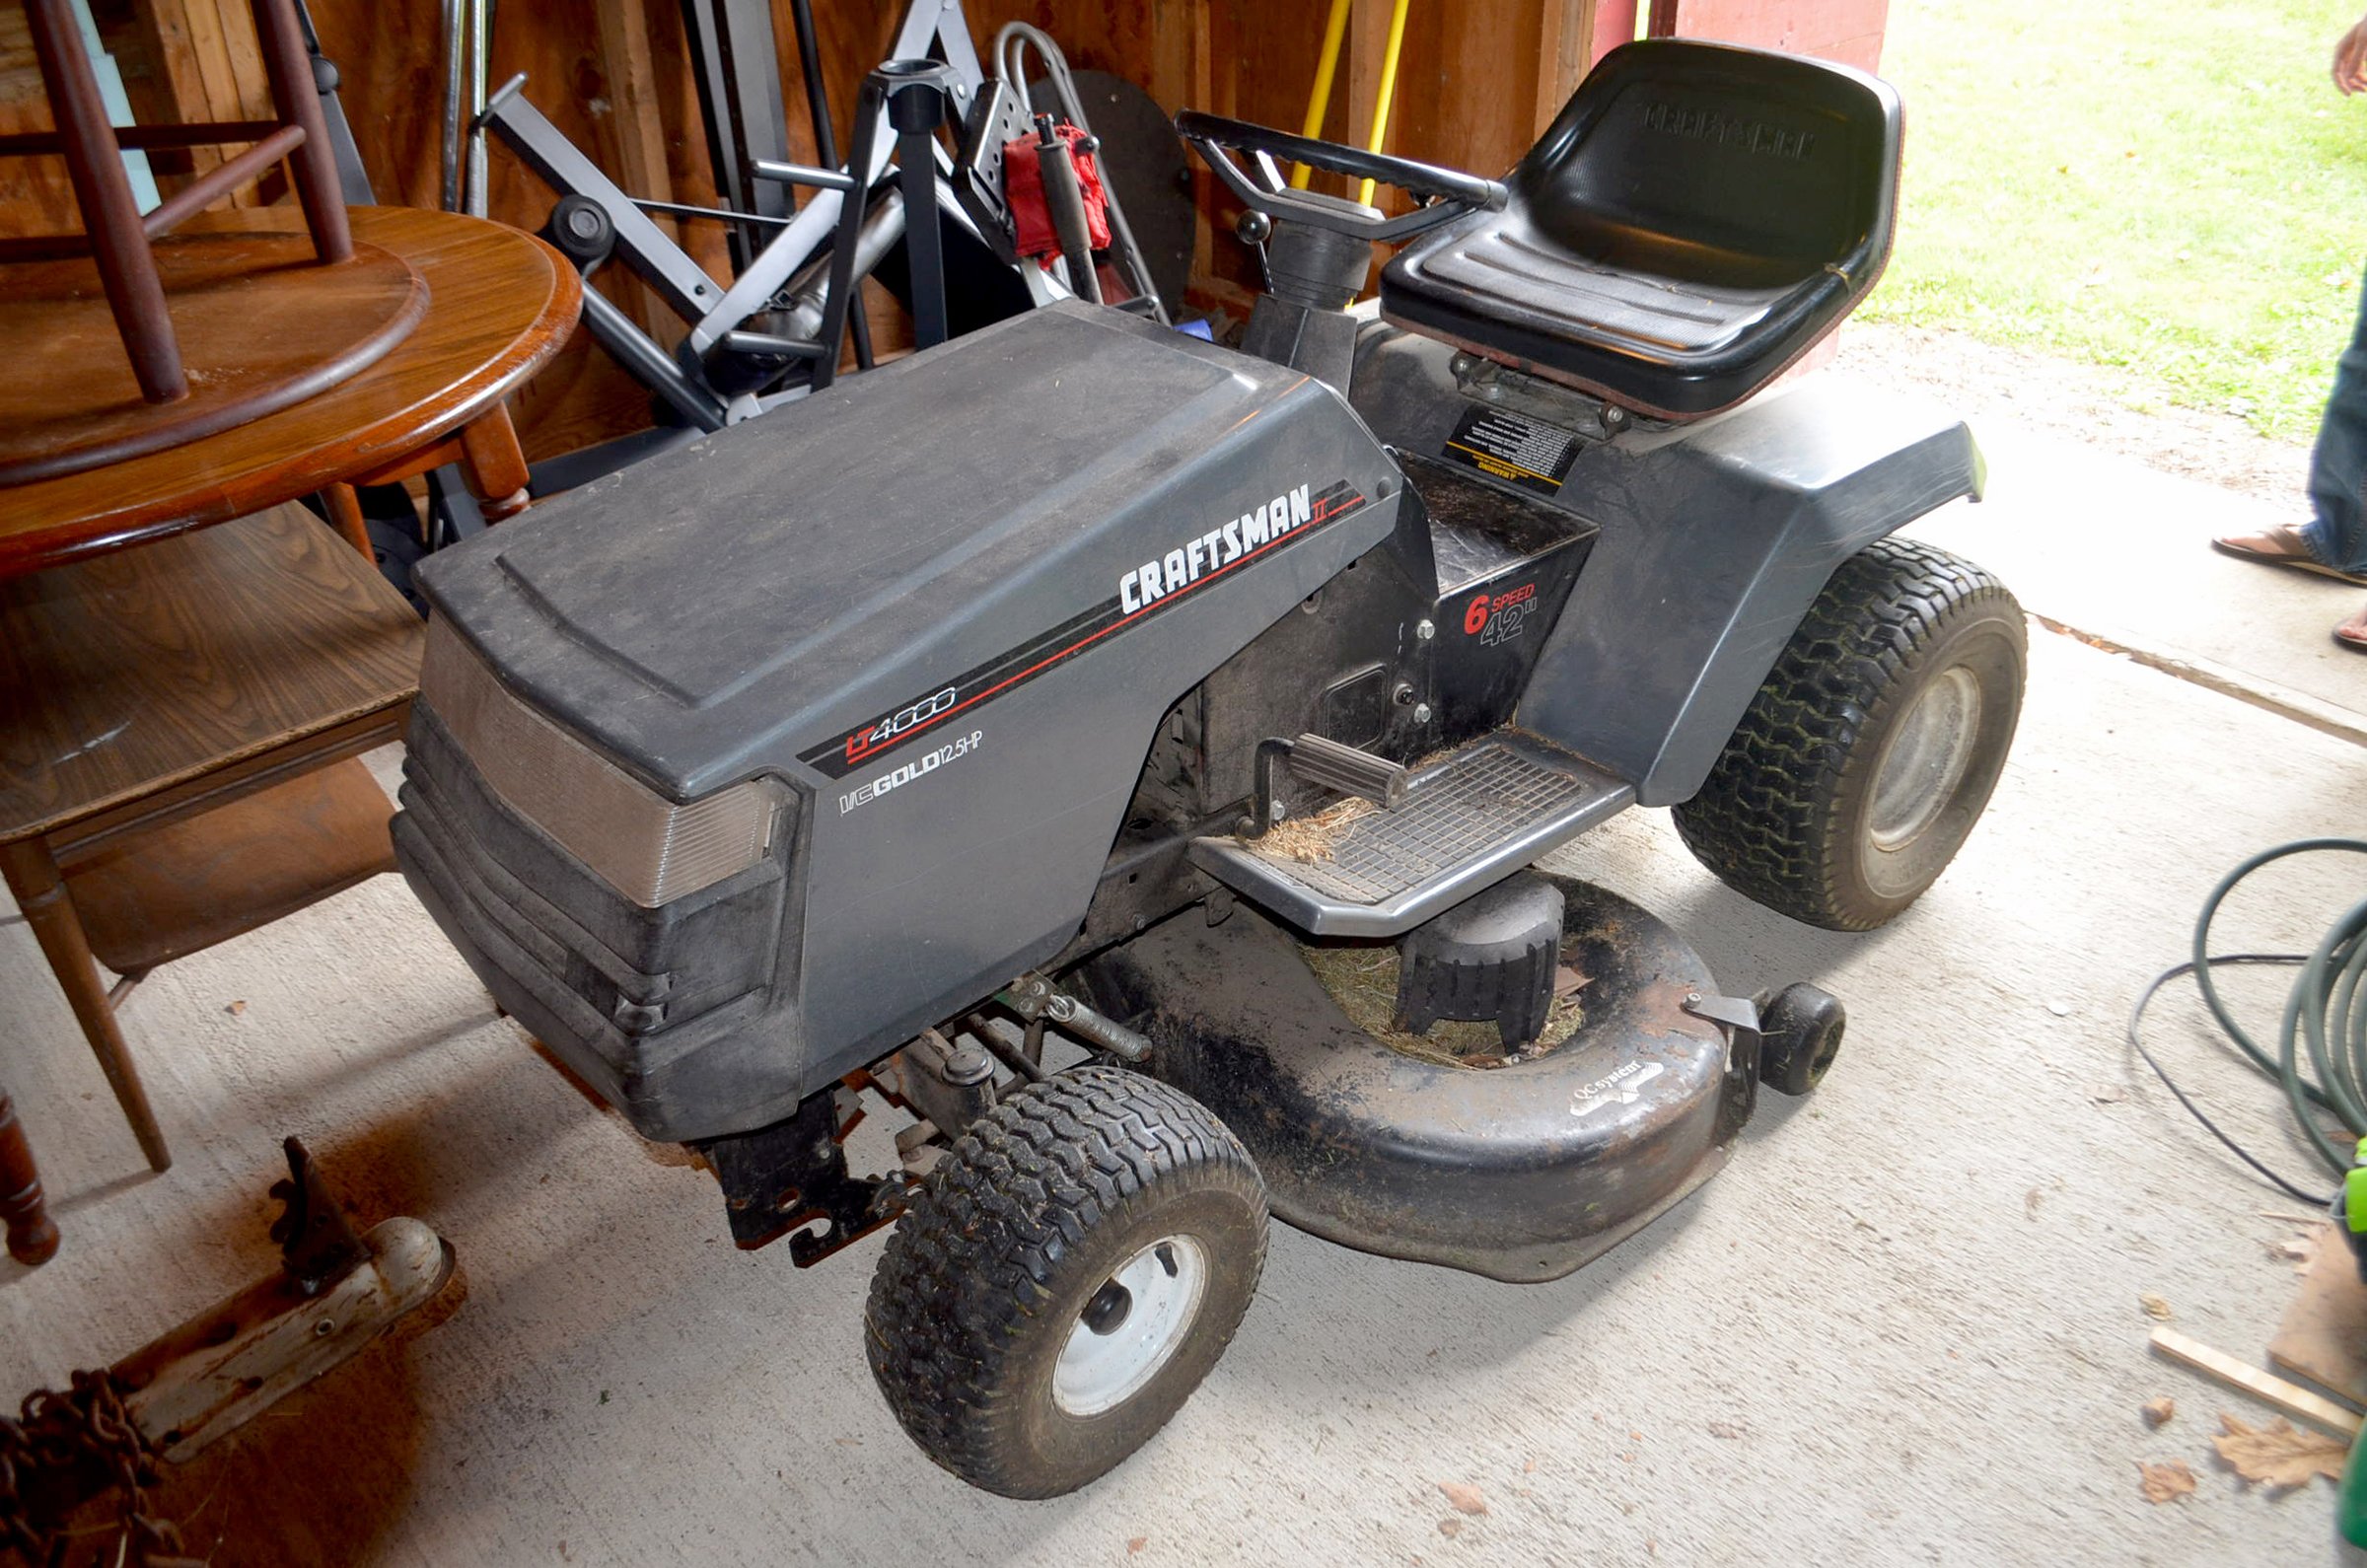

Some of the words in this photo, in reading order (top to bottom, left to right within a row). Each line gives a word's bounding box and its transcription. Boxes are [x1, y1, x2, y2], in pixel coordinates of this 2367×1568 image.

[1119, 483, 1311, 614] CRAFTSMAN
[1312, 498, 1327, 524] II
[1465, 595, 1490, 634] 6
[1491, 583, 1535, 612] SPEED
